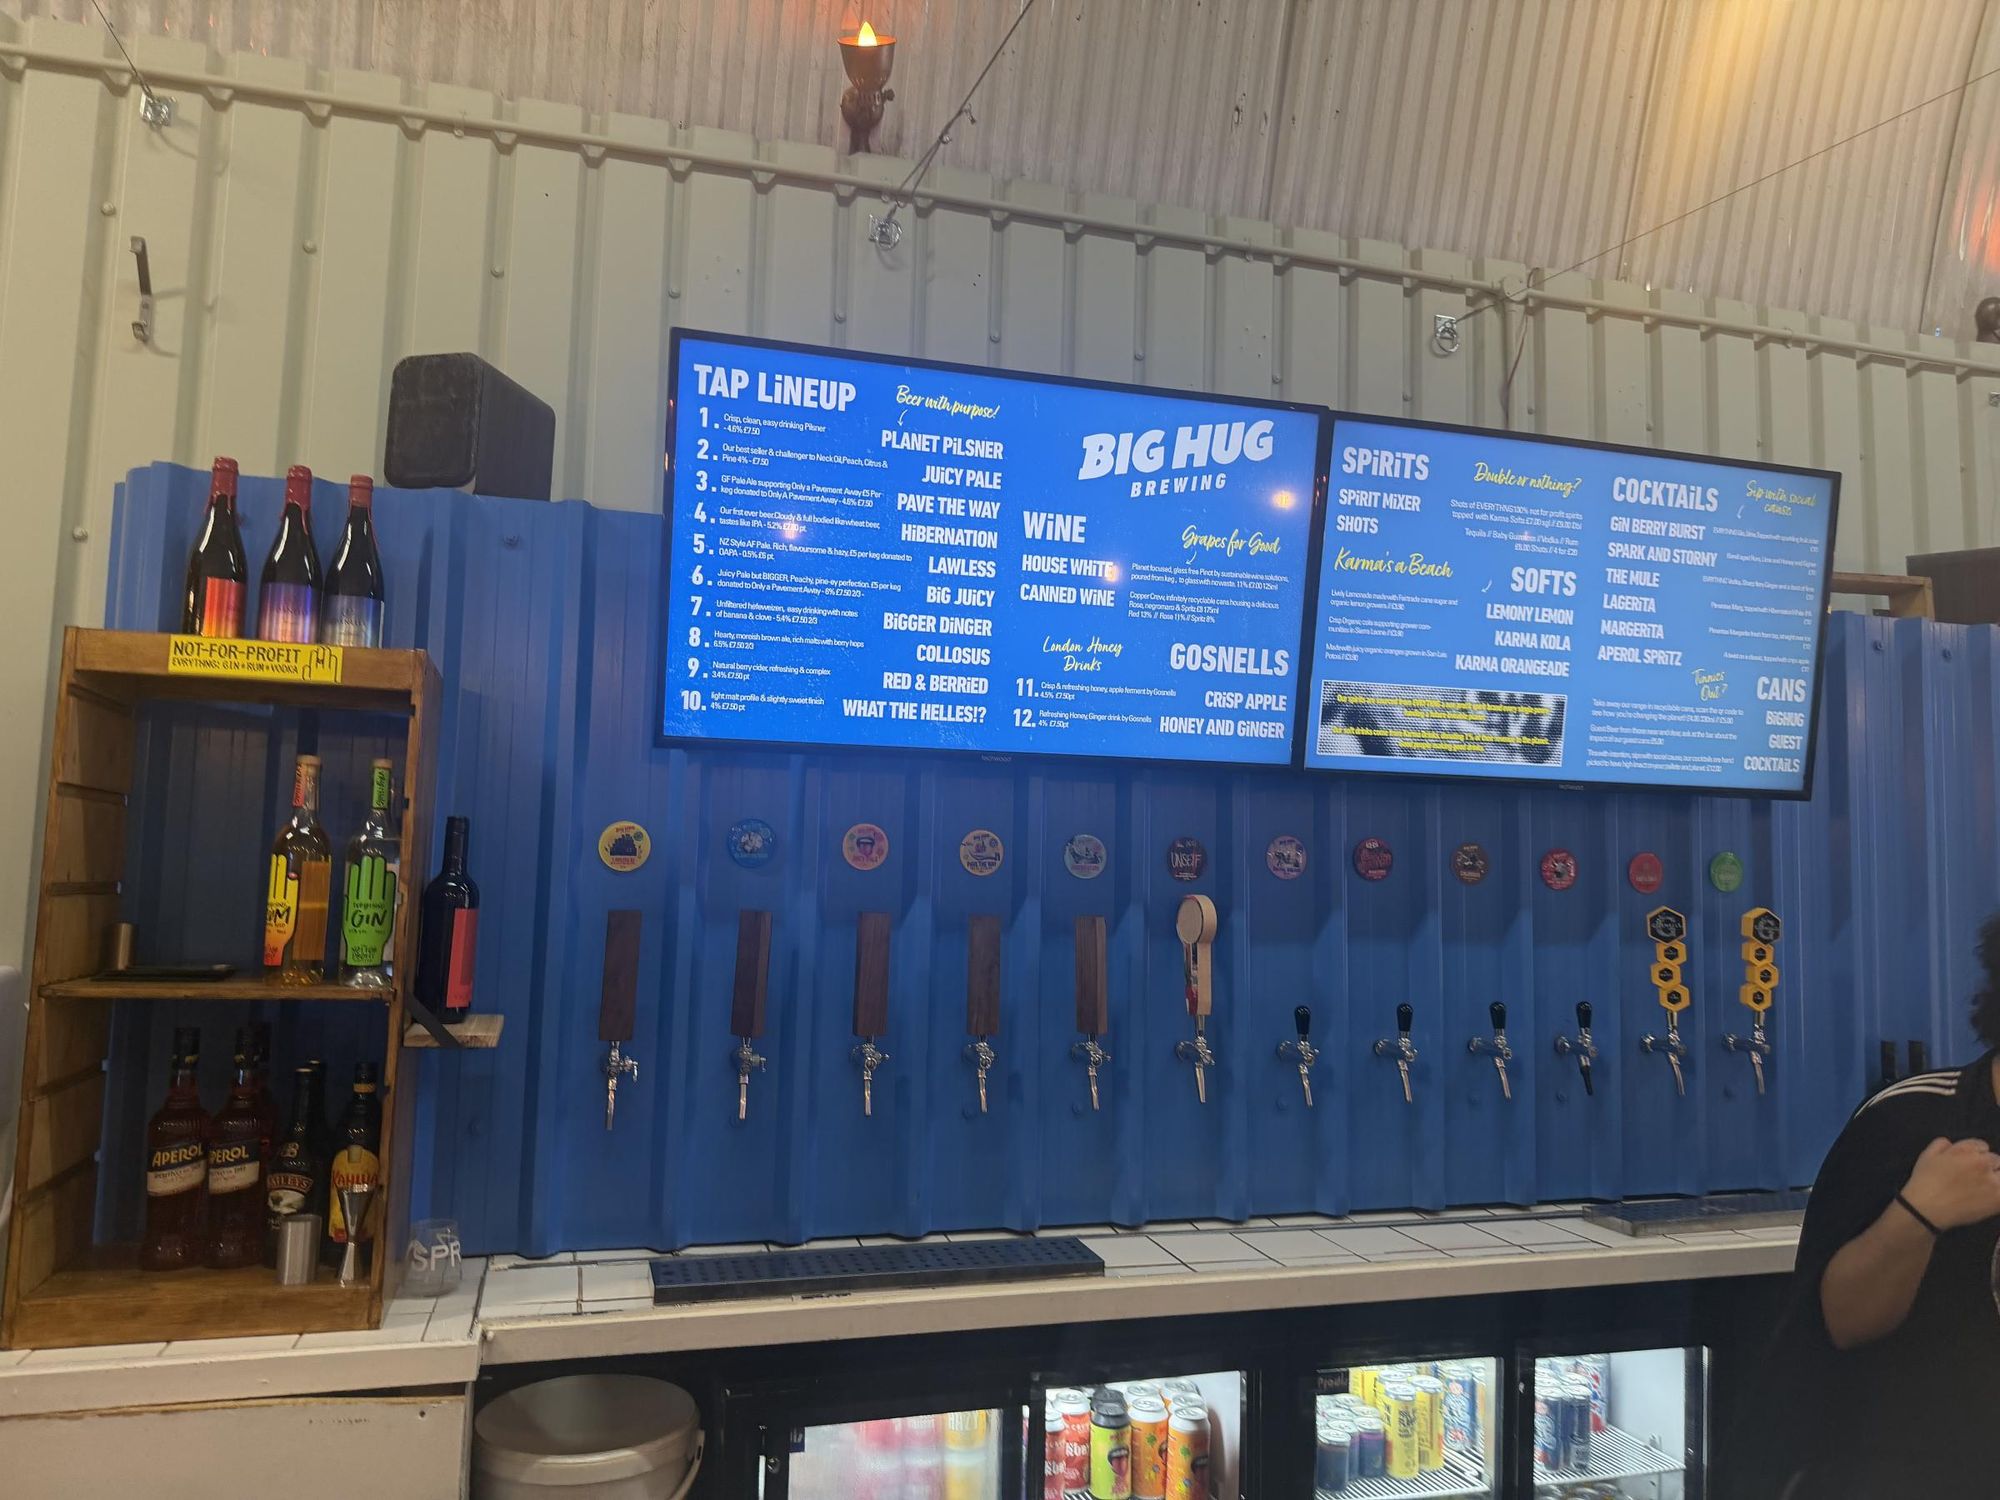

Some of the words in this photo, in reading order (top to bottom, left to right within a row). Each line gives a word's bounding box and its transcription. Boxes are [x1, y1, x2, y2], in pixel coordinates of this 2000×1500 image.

[693, 363, 749, 398] TAP
[758, 372, 856, 411] LiNEUP
[896, 384, 927, 407] Beer
[924, 395, 953, 414] with
[950, 400, 1000, 419] purpose!
[763, 419, 779, 427] easy
[779, 420, 803, 431] drinking
[804, 422, 826, 431] Pilsner
[881, 429, 940, 452] PLANET
[942, 436, 1003, 459] PiLSNER
[1078, 429, 1165, 480] BIG
[1171, 419, 1274, 469] HUG
[774, 450, 809, 460] challenger
[731, 475, 745, 484] Pale
[757, 480, 790, 490] supporting
[791, 482, 806, 491] Only
[811, 484, 842, 493] Pavement
[921, 465, 963, 485] JUiCY
[965, 469, 1001, 489] PALE
[1130, 472, 1226, 497] BREWING
[1473, 462, 1516, 485] Double
[1515, 475, 1529, 486] or
[1529, 474, 1582, 498] nothing?
[733, 487, 760, 496] donated
[1612, 476, 1718, 512] COCKTAiLS
[897, 493, 934, 513] PAVE
[937, 496, 965, 516] THE
[968, 499, 1000, 519] WAY
[812, 514, 834, 524] bodied
[1023, 510, 1086, 543] WiNE
[1336, 514, 1378, 534] SHOTS
[1631, 518, 1668, 536] BERRY
[1668, 522, 1706, 540] BURST
[901, 523, 997, 548] HiBERNATION
[1182, 524, 1227, 551] Grapes
[1226, 528, 1247, 557] for
[1248, 531, 1280, 555] Good
[788, 543, 826, 553] flavoursome
[1607, 542, 1646, 560] SPARK
[1646, 546, 1671, 562] AND
[1672, 548, 1717, 567] STORMY
[928, 556, 995, 577] LAWLESS
[1022, 554, 1068, 574] HOUSE
[1334, 546, 1393, 572] Karma's
[1394, 561, 1407, 573] a
[1408, 553, 1453, 577] Beach
[717, 569, 735, 578] Juicy
[736, 570, 750, 578] Pale
[1510, 566, 1576, 596] SOFTS
[1606, 568, 1628, 584] THE
[1629, 570, 1659, 587] MULE
[716, 600, 747, 608] Unfiltered
[953, 588, 995, 606] JUiCY
[1020, 583, 1076, 603] CANNED
[1079, 588, 1115, 606] WiNE
[722, 610, 747, 619] banana
[883, 612, 936, 632] BiGGER
[939, 616, 992, 636] DiNGER
[1486, 603, 1533, 621] LEMONY
[1534, 607, 1573, 625] LEMON
[1042, 635, 1083, 652] London
[1086, 636, 1123, 657] Honey
[1494, 630, 1538, 648] KARMA
[1540, 634, 1571, 650] KOLA
[174, 641, 301, 663] NOT-FOR-PROFIT
[916, 644, 990, 665] COLLOSUS
[1063, 654, 1102, 671] Drinks
[1170, 642, 1289, 676] GOSNELLS
[1597, 645, 1641, 662] APEROL
[222, 660, 240, 670] GIN
[712, 661, 736, 669] Natural
[735, 662, 752, 671] berry
[768, 665, 798, 674] refreshing
[1455, 654, 1498, 672] KARMA
[1500, 657, 1569, 676] ORANGEADE
[883, 672, 911, 689] RED
[914, 674, 926, 690] &
[929, 674, 988, 694] BERRiED
[1016, 677, 1038, 697] 11.
[1061, 683, 1089, 692] refreshing
[1108, 686, 1124, 695] apple
[1153, 688, 1176, 696] Gosnells
[1756, 676, 1806, 702] CANS
[681, 690, 706, 710] 10.
[740, 693, 759, 701] profile
[1204, 690, 1243, 708] CRiSP
[1244, 693, 1287, 711] APPLE
[842, 699, 887, 717] WHAT
[889, 701, 917, 719] THE
[920, 703, 986, 723] HELLES!?
[1013, 708, 1036, 727] 12.
[1088, 712, 1107, 721] Ginger
[1128, 714, 1152, 722] Gosnells
[1159, 716, 1203, 734] HONEY
[1205, 718, 1234, 735] AND
[1236, 720, 1284, 738] GiNGER
[1768, 734, 1803, 749] GUEST
[351, 910, 387, 928] GIN
[152, 1142, 203, 1168] APEROL
[208, 1146, 250, 1164] PEROL
